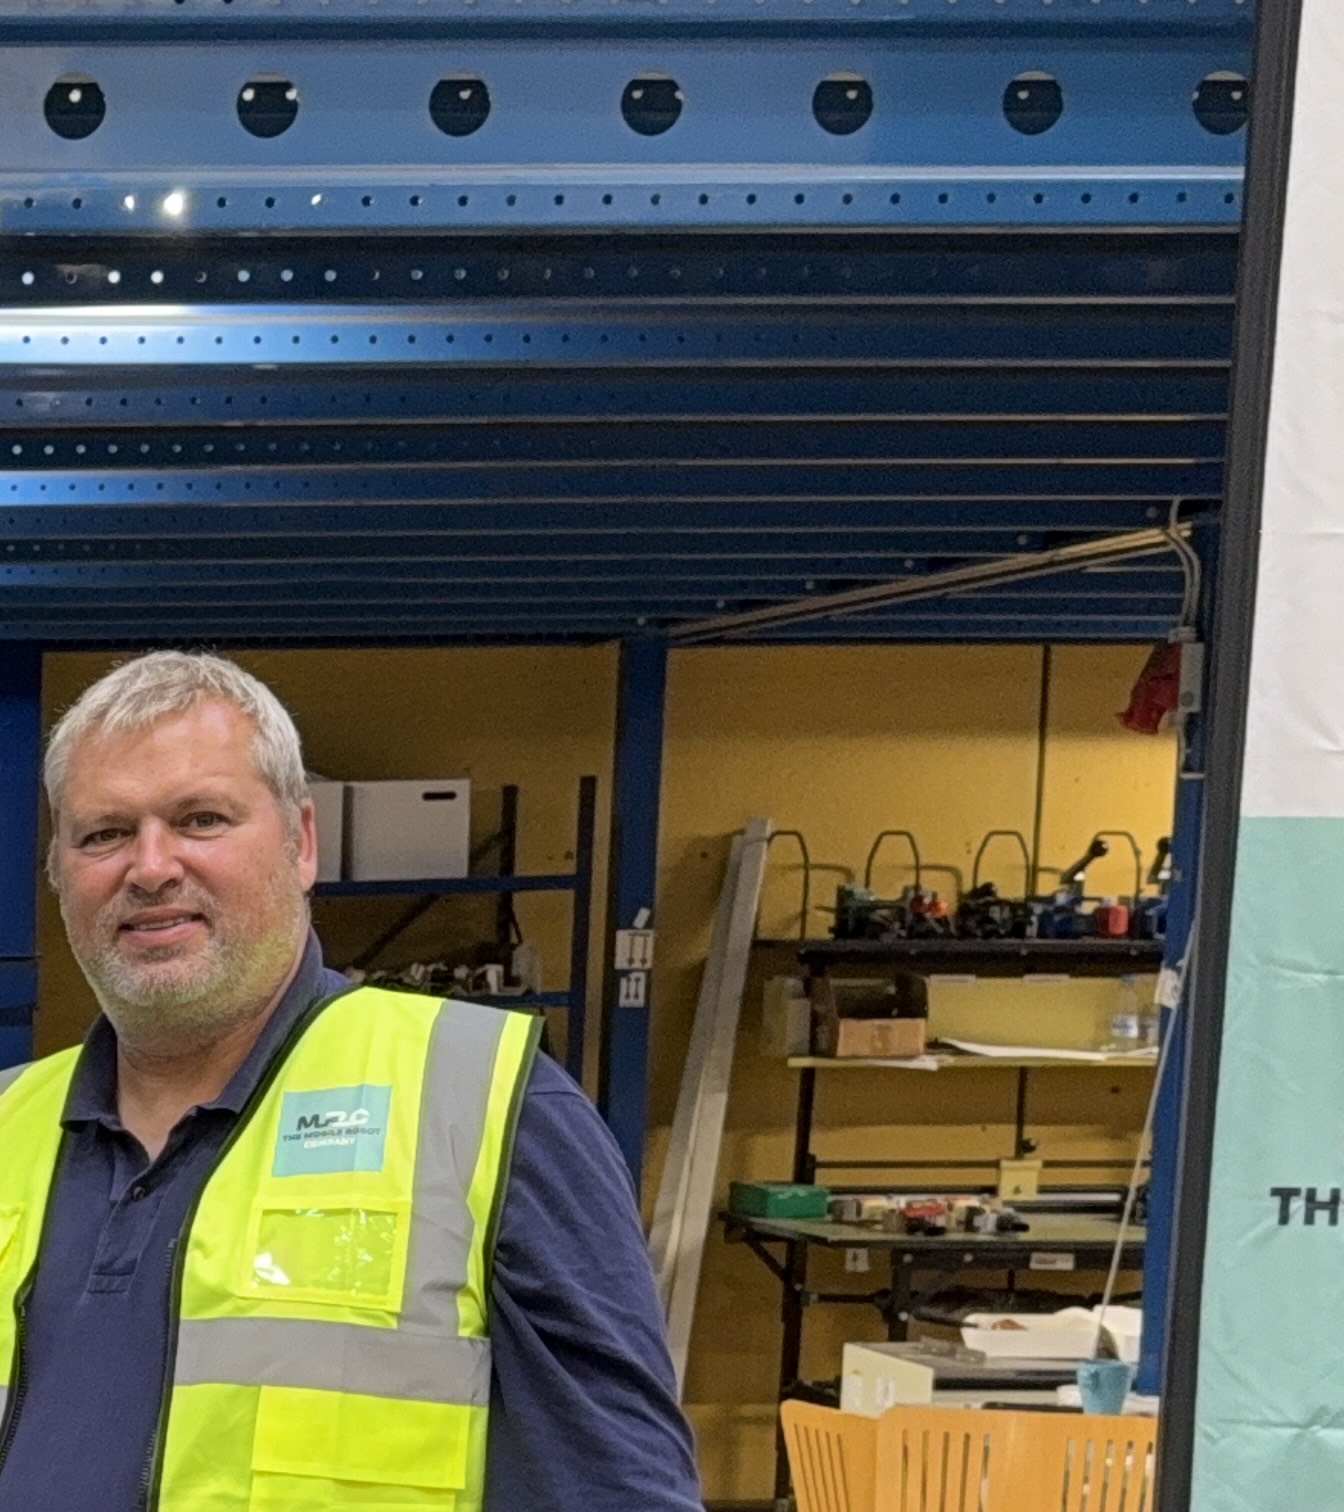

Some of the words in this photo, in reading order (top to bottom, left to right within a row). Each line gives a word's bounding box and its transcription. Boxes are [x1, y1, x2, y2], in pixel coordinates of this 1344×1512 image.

[282, 1132, 302, 1142] THE
[304, 1129, 343, 1140] MOBILE
[344, 1126, 381, 1136] ROBOT
[303, 1137, 356, 1149] COMPANY
